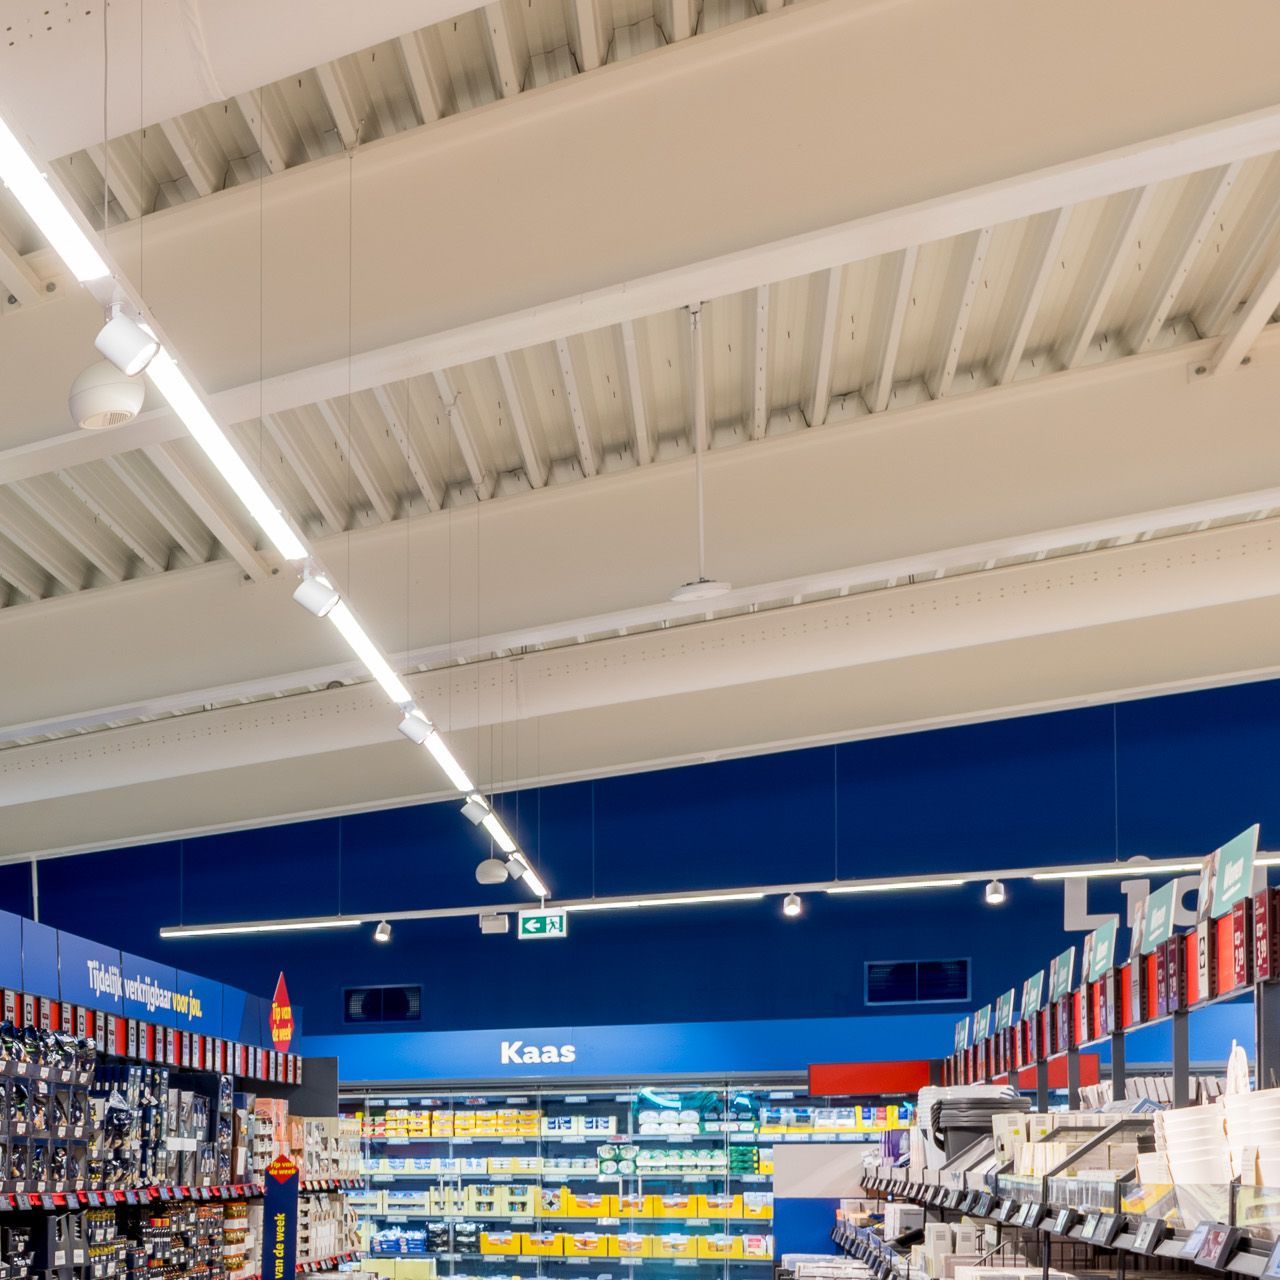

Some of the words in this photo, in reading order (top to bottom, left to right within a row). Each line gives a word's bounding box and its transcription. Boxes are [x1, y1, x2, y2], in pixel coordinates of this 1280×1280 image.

[87, 959, 123, 1003] Tijdelijk
[124, 975, 171, 1012] verkrijgbaar
[172, 992, 189, 1014] voor
[189, 989, 202, 1021] jou.
[271, 1003, 281, 1021] Tip
[281, 1004, 292, 1016] van
[272, 1024, 279, 1041] de
[279, 1025, 292, 1041] week
[501, 1041, 576, 1064] Kaas
[269, 1160, 281, 1169] Tip
[279, 1167, 296, 1175] week
[275, 1213, 285, 1242] week
[273, 1243, 283, 1257] de
[274, 1258, 283, 1278] van
